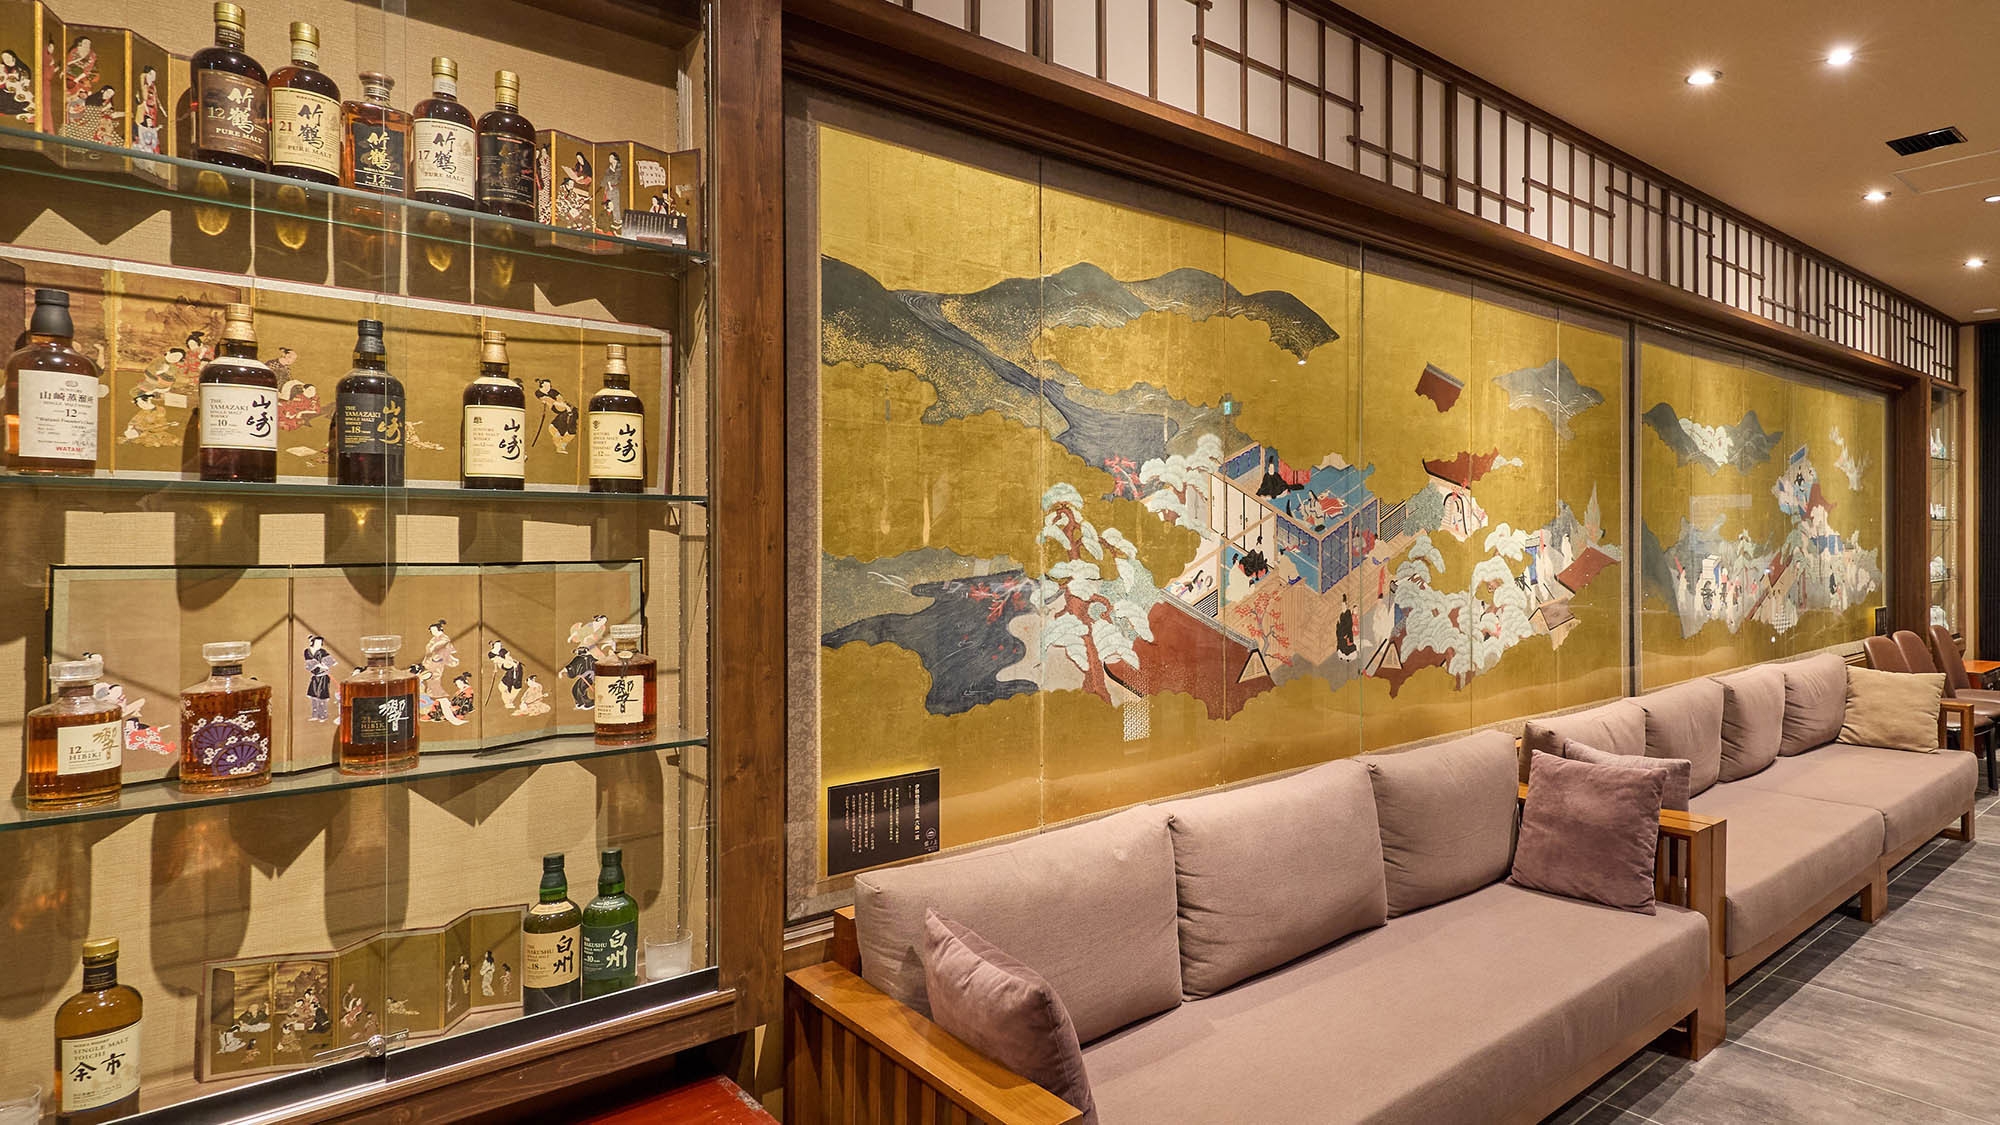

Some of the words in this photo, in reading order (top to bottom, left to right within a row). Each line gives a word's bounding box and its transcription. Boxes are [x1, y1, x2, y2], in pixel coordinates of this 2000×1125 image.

[207, 106, 226, 119] 12
[227, 87, 254, 134] 竹鶴
[215, 127, 241, 138] PURE
[242, 133, 263, 144] MALT
[279, 120, 293, 132] 21
[298, 103, 324, 150] 竹鶴
[287, 144, 310, 153] PURE
[312, 148, 332, 159] MALT
[366, 131, 391, 171] 竹鶴
[418, 150, 431, 161] 17
[432, 131, 458, 175] 竹鶴
[372, 174, 386, 185] 12
[446, 174, 465, 182] MALT
[66, 409, 78, 418] 12
[217, 419, 228, 427] 10
[246, 394, 274, 439] 山崎
[376, 399, 403, 444] 山崎
[351, 425, 361, 434] 18
[498, 417, 523, 461] 山崎
[614, 423, 639, 463] 山崎
[608, 679, 639, 714] 響
[378, 699, 410, 732] 響
[69, 746, 82, 755] 12
[69, 751, 102, 760] HIBIKI
[92, 727, 120, 761] 響
[553, 934, 574, 975] 白州
[606, 929, 628, 969] 白州
[73, 1044, 106, 1055] SINGLE
[108, 1036, 129, 1048] MALT
[73, 1051, 106, 1061] YOICHI
[69, 1053, 126, 1082] 余市
